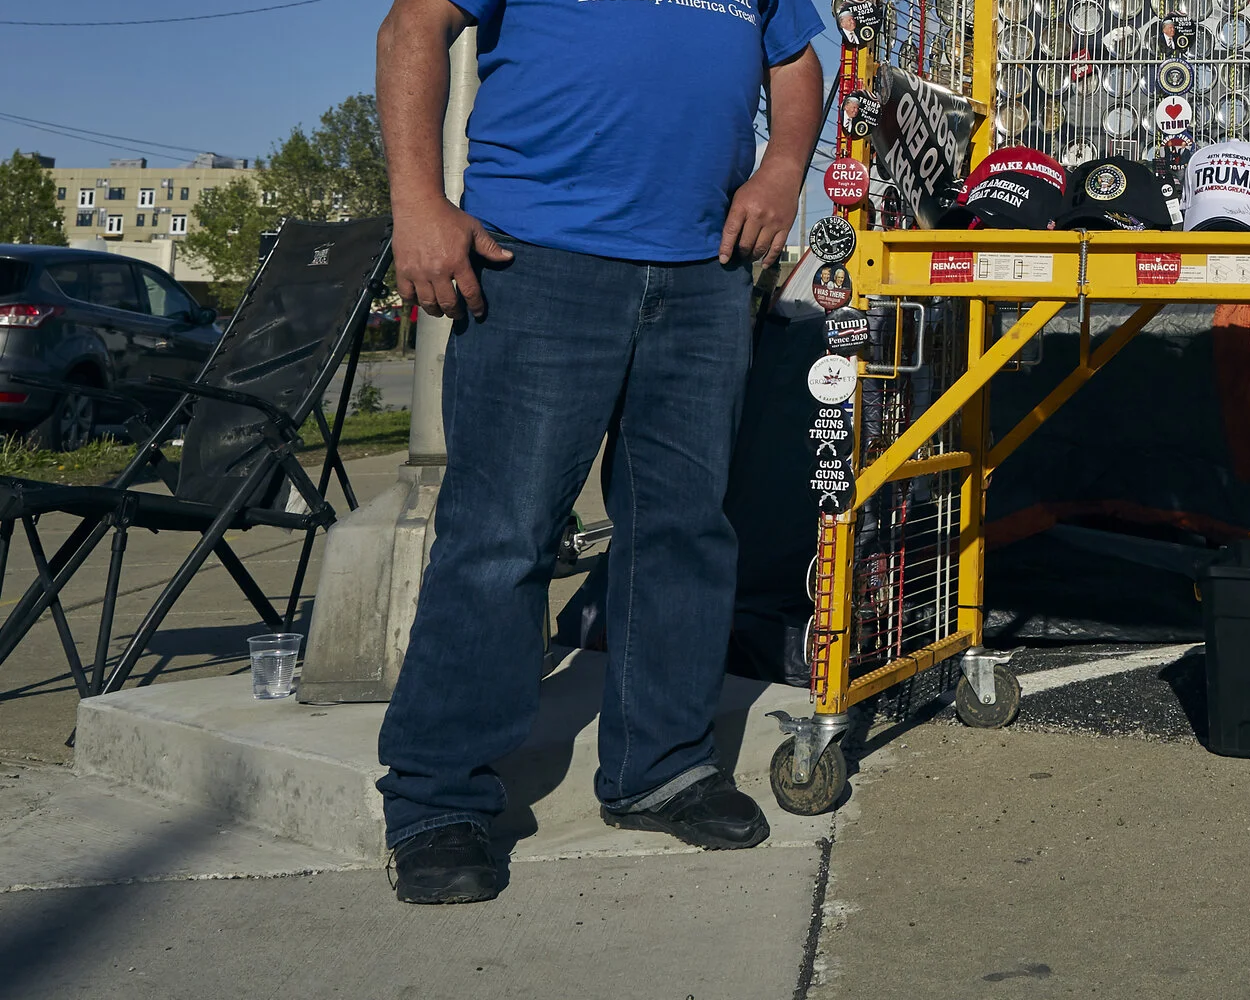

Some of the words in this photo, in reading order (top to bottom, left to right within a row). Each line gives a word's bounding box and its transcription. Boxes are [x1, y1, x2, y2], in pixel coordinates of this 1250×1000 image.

[849, 1, 873, 13] TRUMP
[857, 8, 874, 16] 20/20
[859, 96, 881, 109] TRUMP
[864, 104, 879, 115] 20/20
[896, 92, 929, 160] END
[1160, 120, 1190, 131] TRUMP
[832, 170, 863, 181] CRUZ
[884, 139, 923, 213] PRAY
[919, 147, 944, 196] TO
[990, 161, 1023, 173] MAKE
[1024, 161, 1064, 185] AMERICA
[828, 187, 863, 197] TEXAS
[987, 178, 1030, 199] AMERICA
[1227, 185, 1246, 194] GREAT
[989, 189, 1024, 208] AGAIN
[829, 217, 852, 235] SUPPORT
[932, 261, 971, 271] RENACCI
[1138, 261, 1178, 272] RENACCI
[817, 288, 829, 296] WAS
[829, 290, 846, 299] THERE
[825, 318, 868, 331] Trump
[828, 336, 850, 345] Pence
[851, 333, 868, 342] 2020
[818, 408, 842, 419] GOD
[814, 419, 844, 430] GUNS
[809, 429, 848, 441] TRUMP
[819, 459, 842, 470] GOD
[815, 470, 845, 480] GUNS
[810, 480, 850, 491] TRUMP
